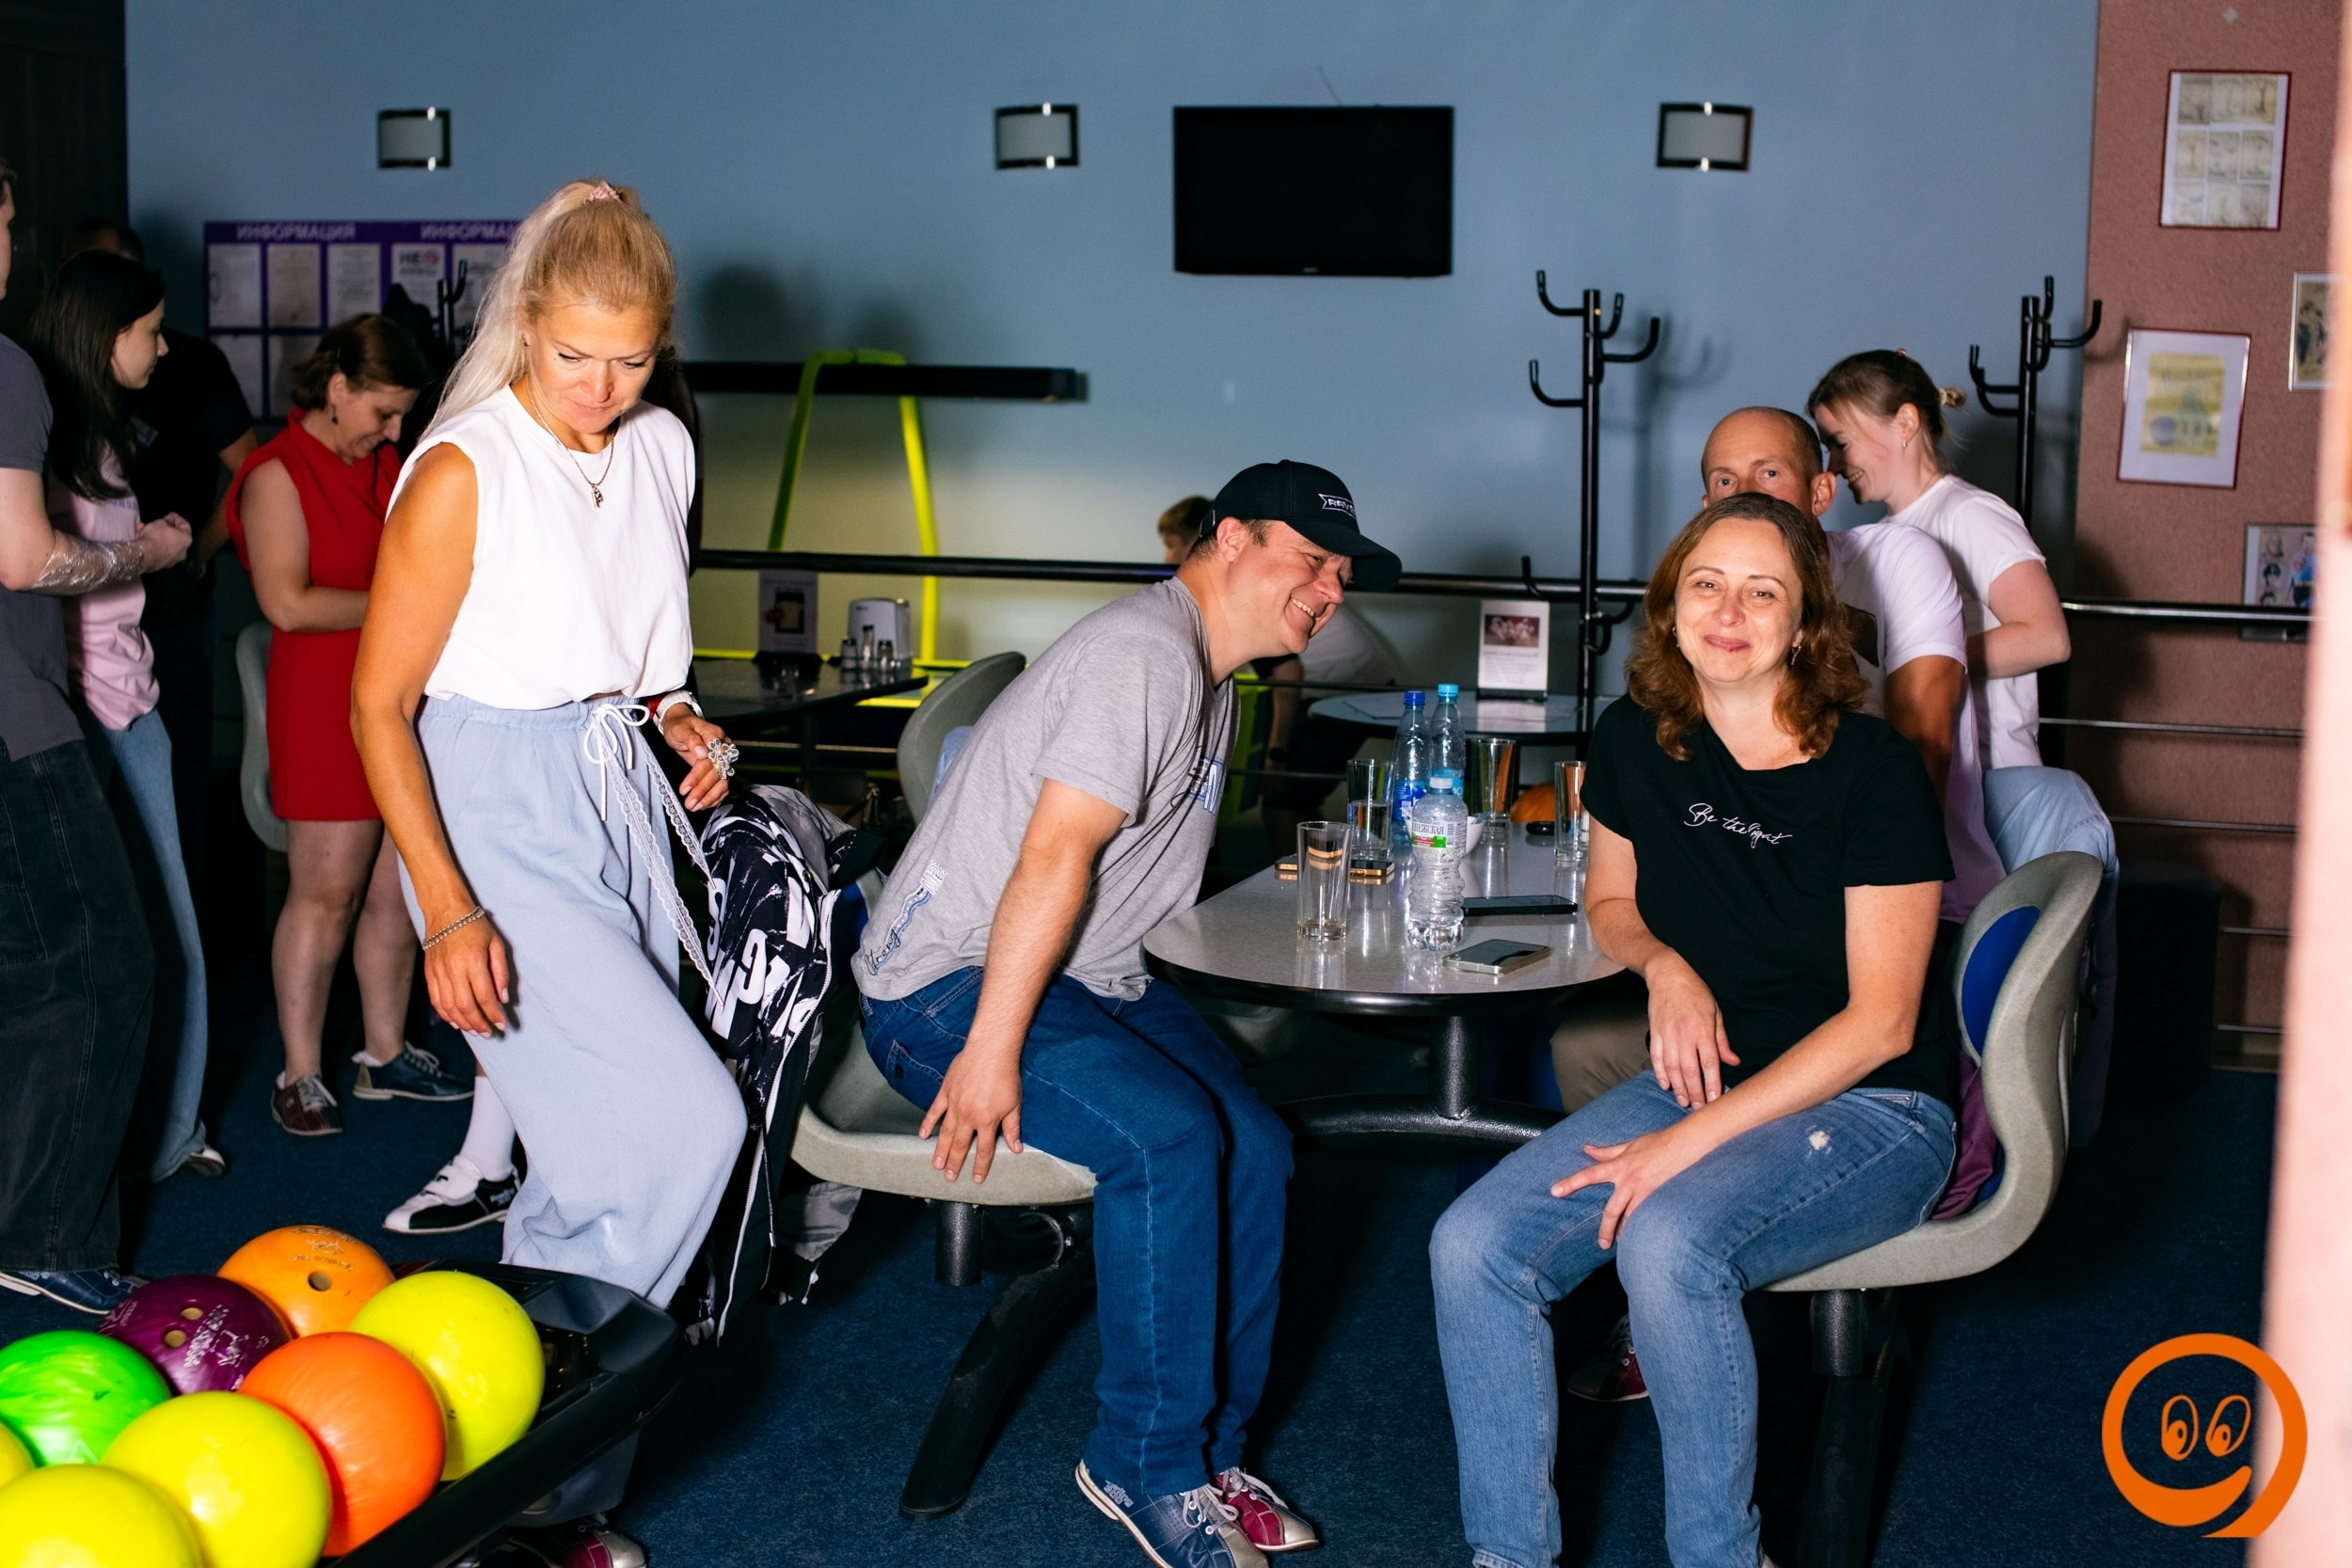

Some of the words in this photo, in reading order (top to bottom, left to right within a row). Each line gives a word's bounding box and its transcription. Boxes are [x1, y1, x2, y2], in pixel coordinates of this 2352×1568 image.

[236, 222, 357, 241] ИНФОРМАЦИЯ
[1684, 802, 1718, 827] Be
[1723, 816, 1748, 834] the
